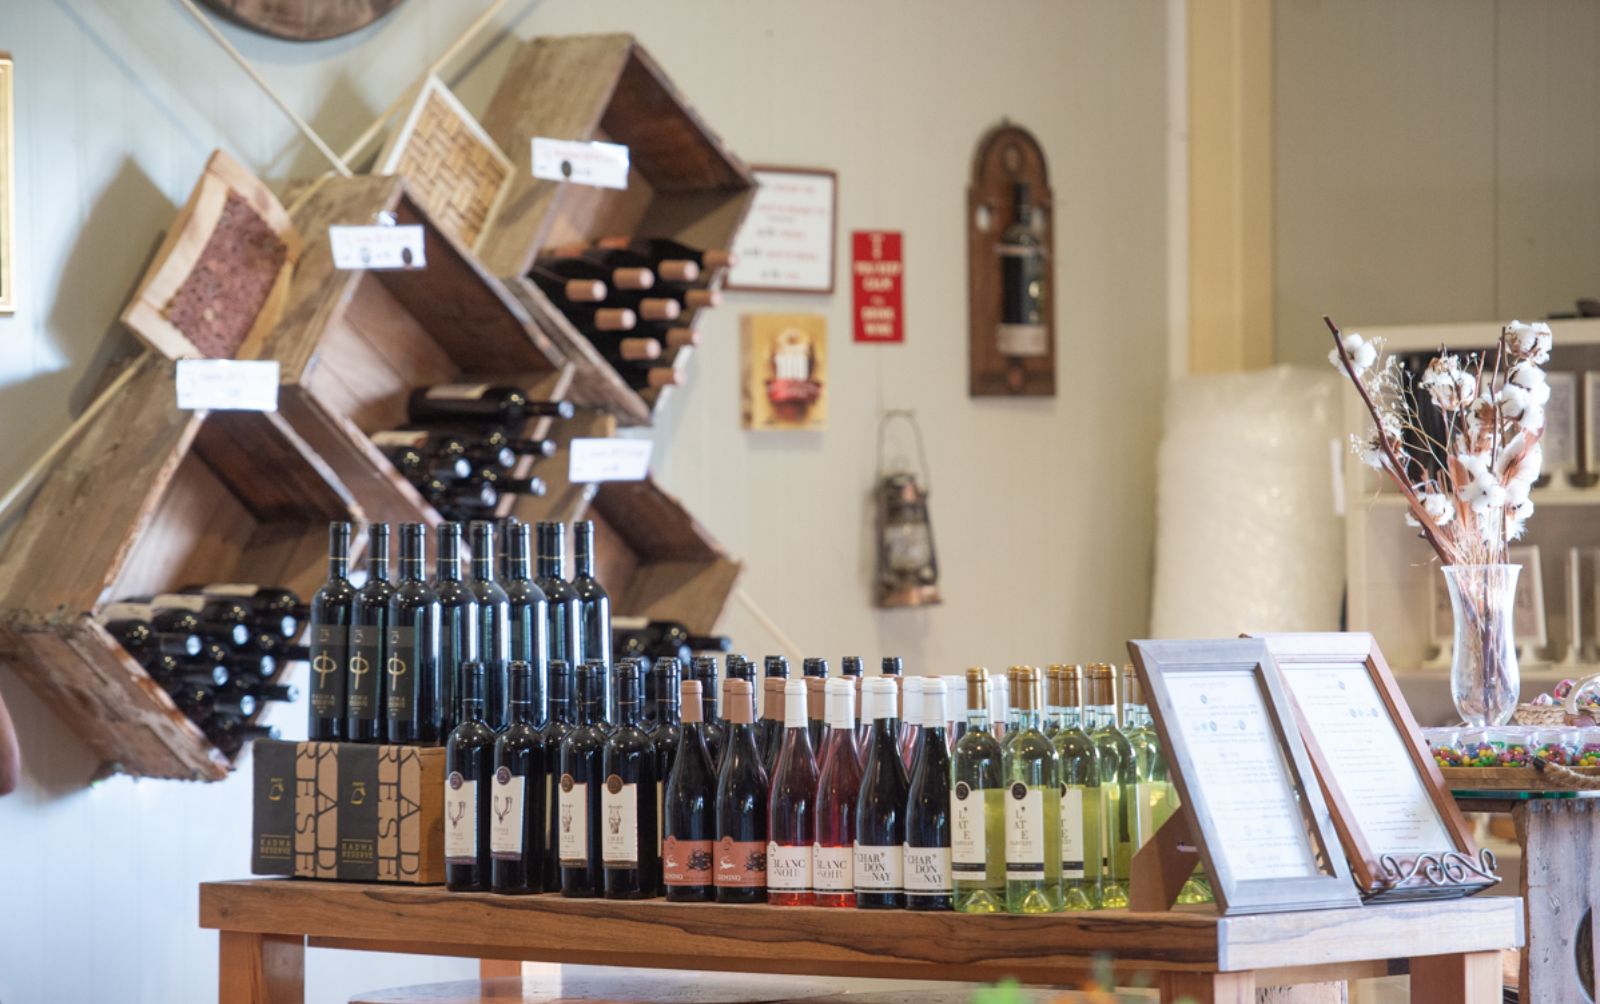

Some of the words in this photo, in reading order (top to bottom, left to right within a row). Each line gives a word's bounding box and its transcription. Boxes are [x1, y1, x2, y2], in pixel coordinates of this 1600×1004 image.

[864, 862, 885, 872] DON
[915, 864, 937, 874] DON
[872, 871, 891, 881] NAY
[923, 873, 944, 883] NAY
